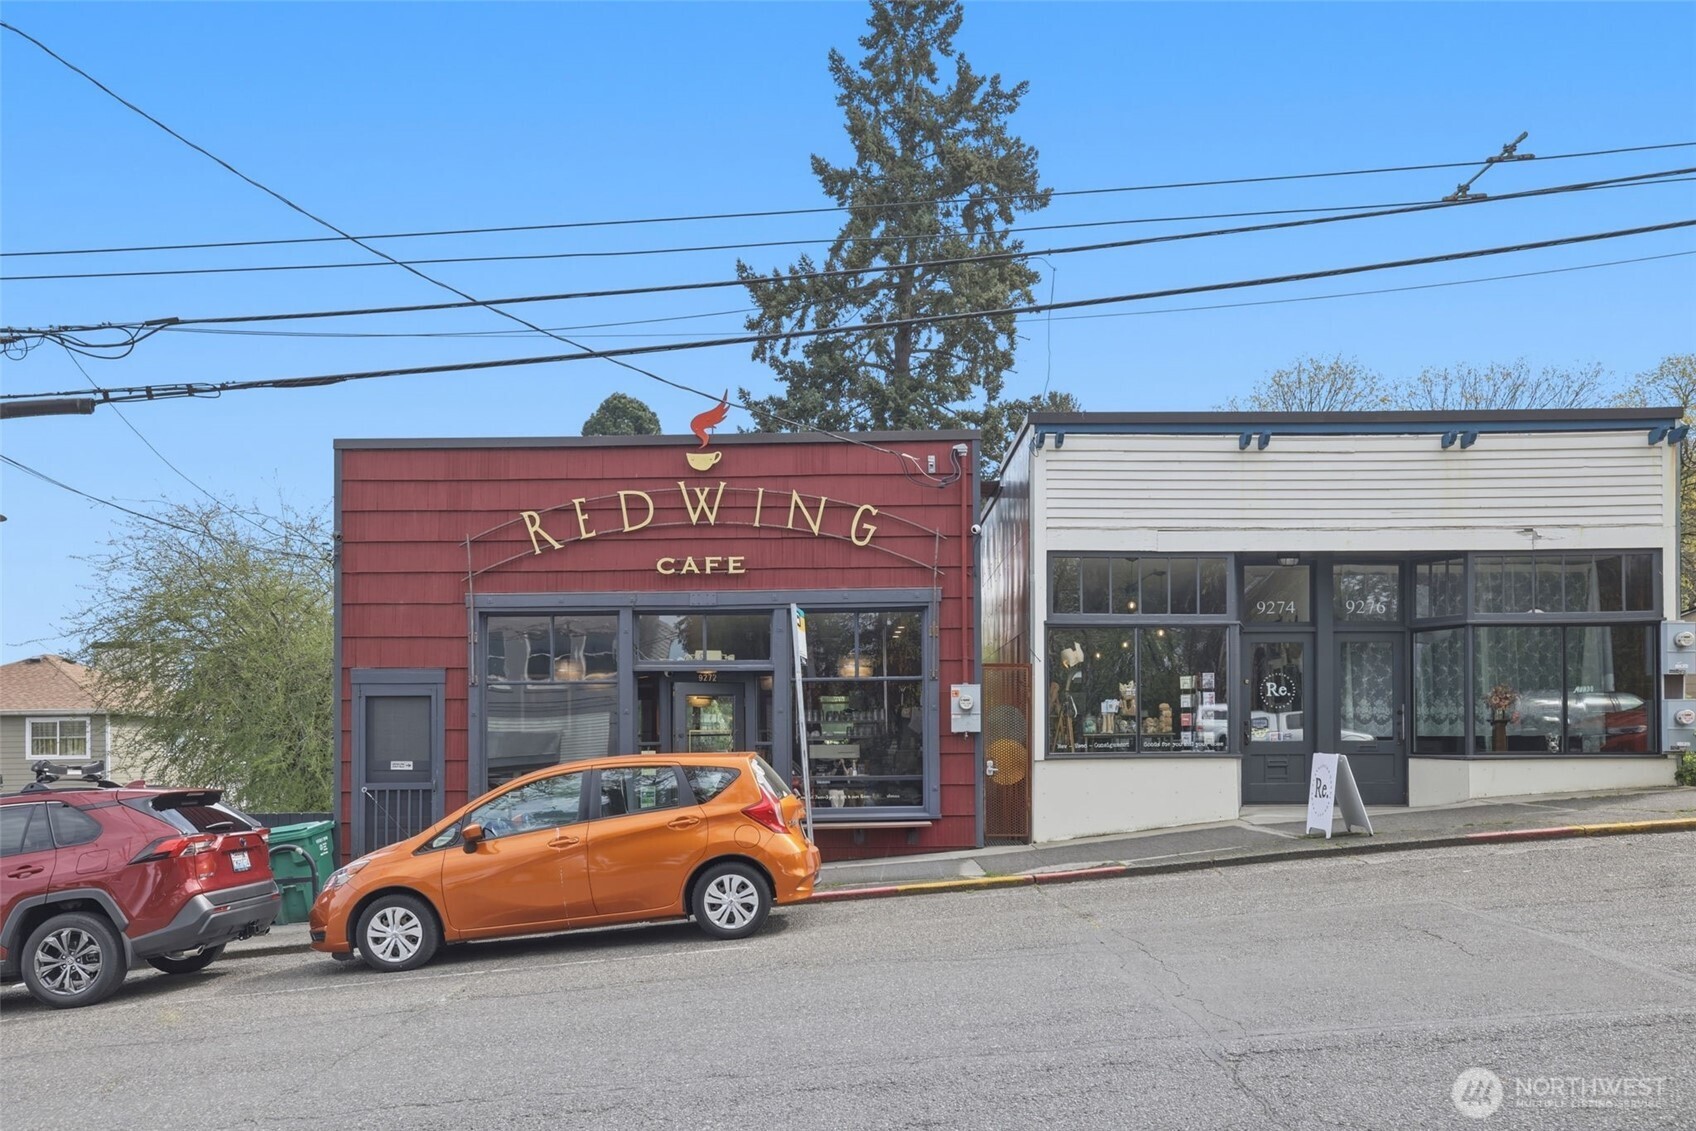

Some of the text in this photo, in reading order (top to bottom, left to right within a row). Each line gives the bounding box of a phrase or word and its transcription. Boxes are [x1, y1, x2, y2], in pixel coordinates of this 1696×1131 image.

[520, 481, 879, 555] REDWING
[656, 556, 747, 575] CAFE
[1256, 601, 1296, 614] 9274
[1345, 600, 1386, 614] 9276
[698, 674, 717, 682] 9272
[1266, 682, 1291, 697] Re.
[1314, 777, 1329, 799] Re.
